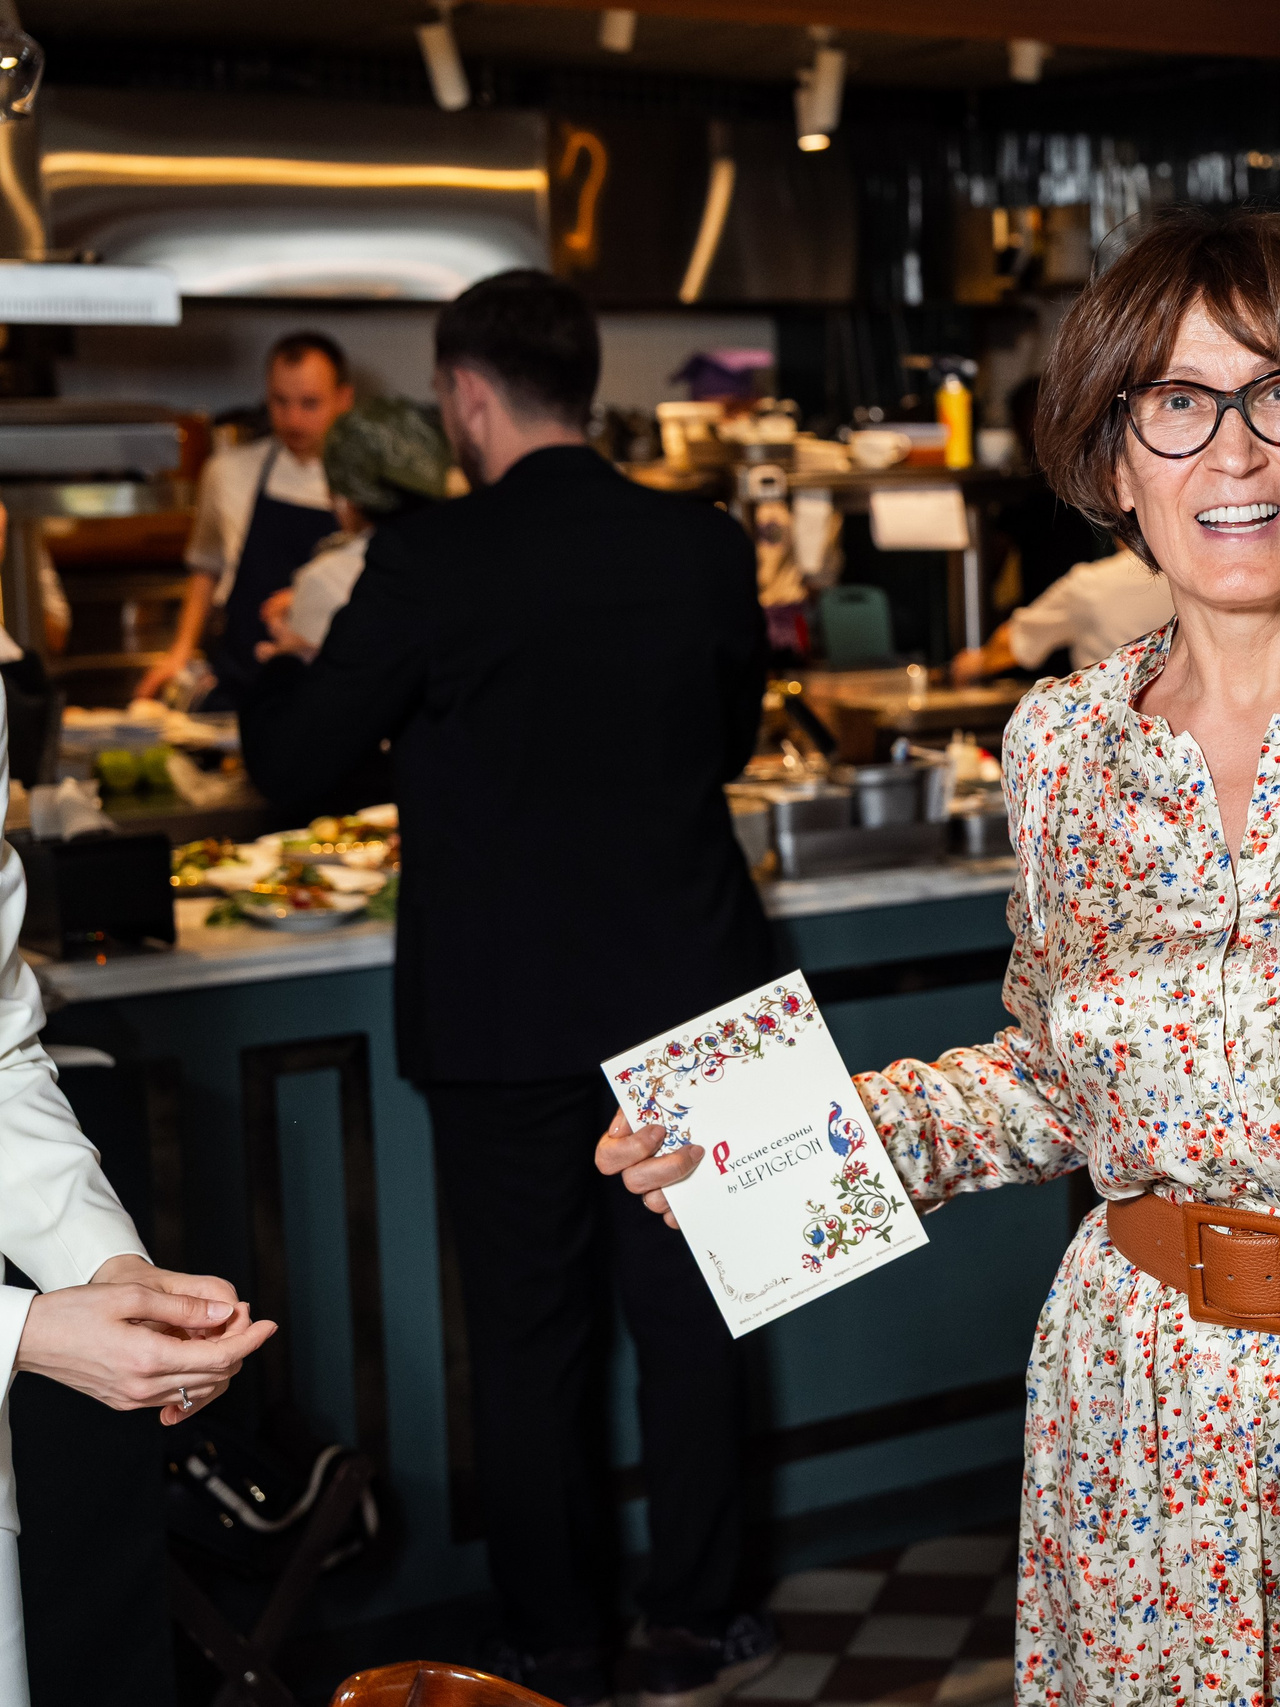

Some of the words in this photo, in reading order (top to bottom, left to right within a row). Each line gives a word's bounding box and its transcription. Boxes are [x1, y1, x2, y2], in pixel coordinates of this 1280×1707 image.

[712, 1140, 769, 1175] Русские
[770, 1125, 813, 1150] сезоны
[727, 1183, 738, 1194] by
